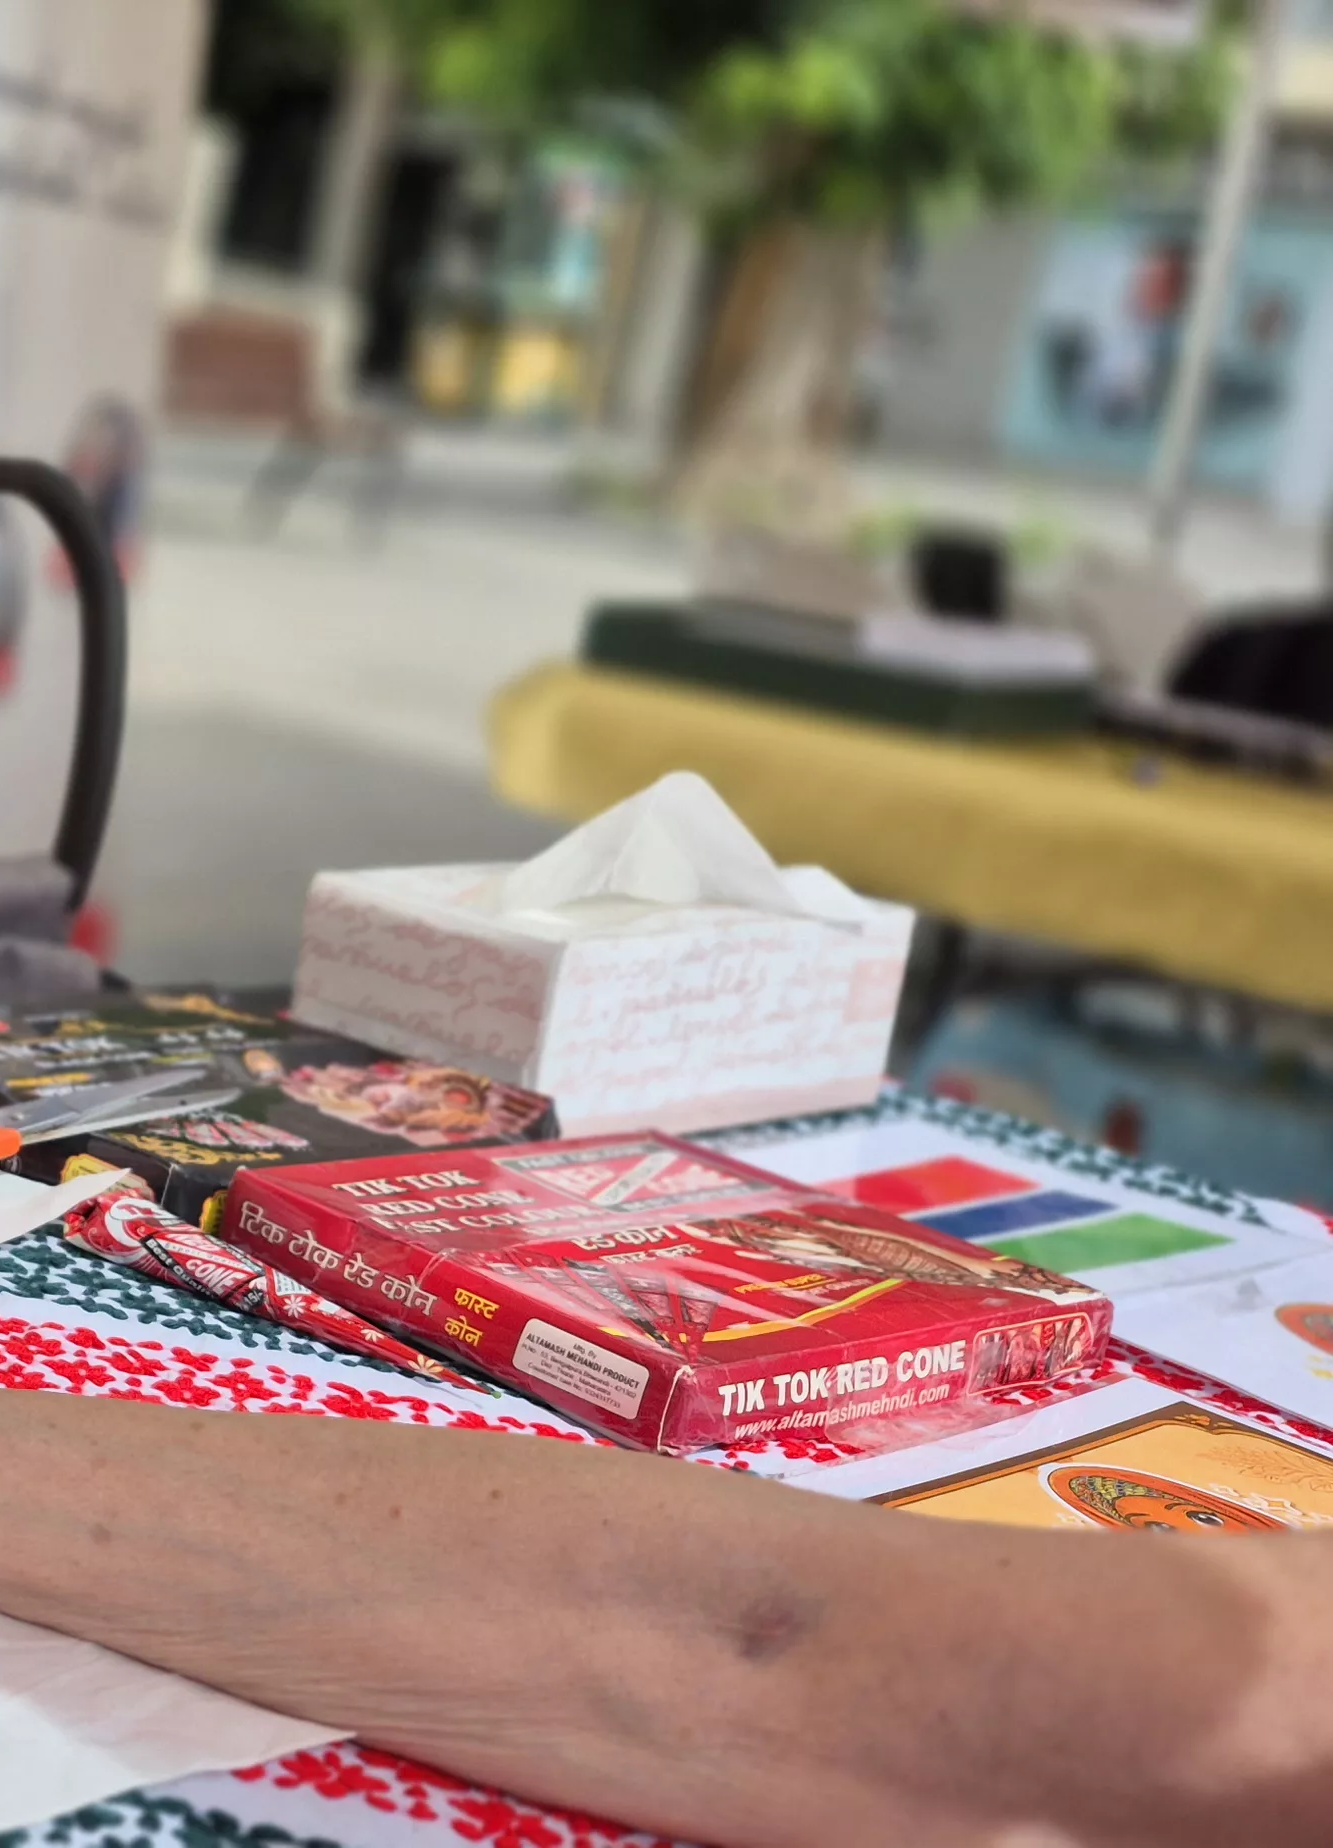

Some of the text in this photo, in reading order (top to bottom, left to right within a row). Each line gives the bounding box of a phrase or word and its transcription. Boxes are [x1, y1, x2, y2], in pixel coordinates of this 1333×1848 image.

[332, 1170, 481, 1197] TIK TOK
[359, 1189, 535, 1216] RED CONE
[144, 1237, 174, 1267] Best
[239, 1200, 288, 1245] टिक
[288, 1229, 344, 1271] टोक
[342, 1252, 381, 1289] रेड
[380, 1271, 440, 1317] कोन
[185, 1258, 247, 1297] CONE
[454, 1287, 500, 1320] फास्ट
[444, 1315, 484, 1348] कोन
[526, 1332, 640, 1389] ALTAMASH MEHANDI PRODUCT
[717, 1339, 968, 1417] TIK TOK RED CONE
[734, 1384, 950, 1440] www.altamashmehndi.com
